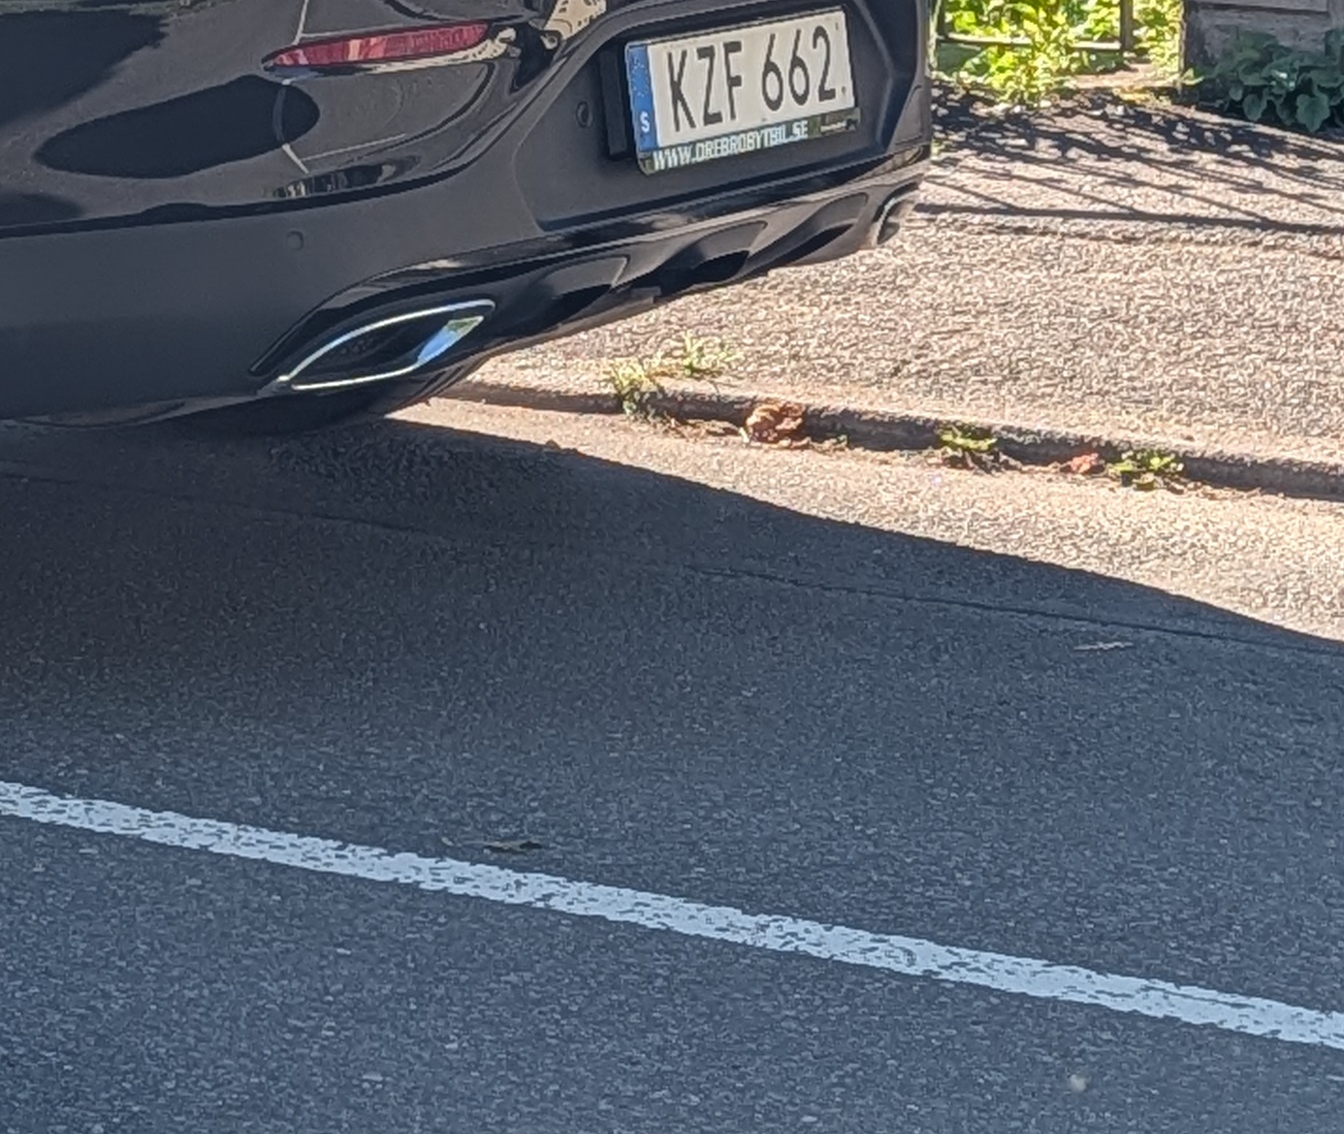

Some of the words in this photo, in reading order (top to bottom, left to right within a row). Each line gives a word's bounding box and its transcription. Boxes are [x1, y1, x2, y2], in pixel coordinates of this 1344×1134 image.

[667, 40, 743, 132] KZF
[762, 25, 836, 112] 662
[640, 110, 650, 133] S
